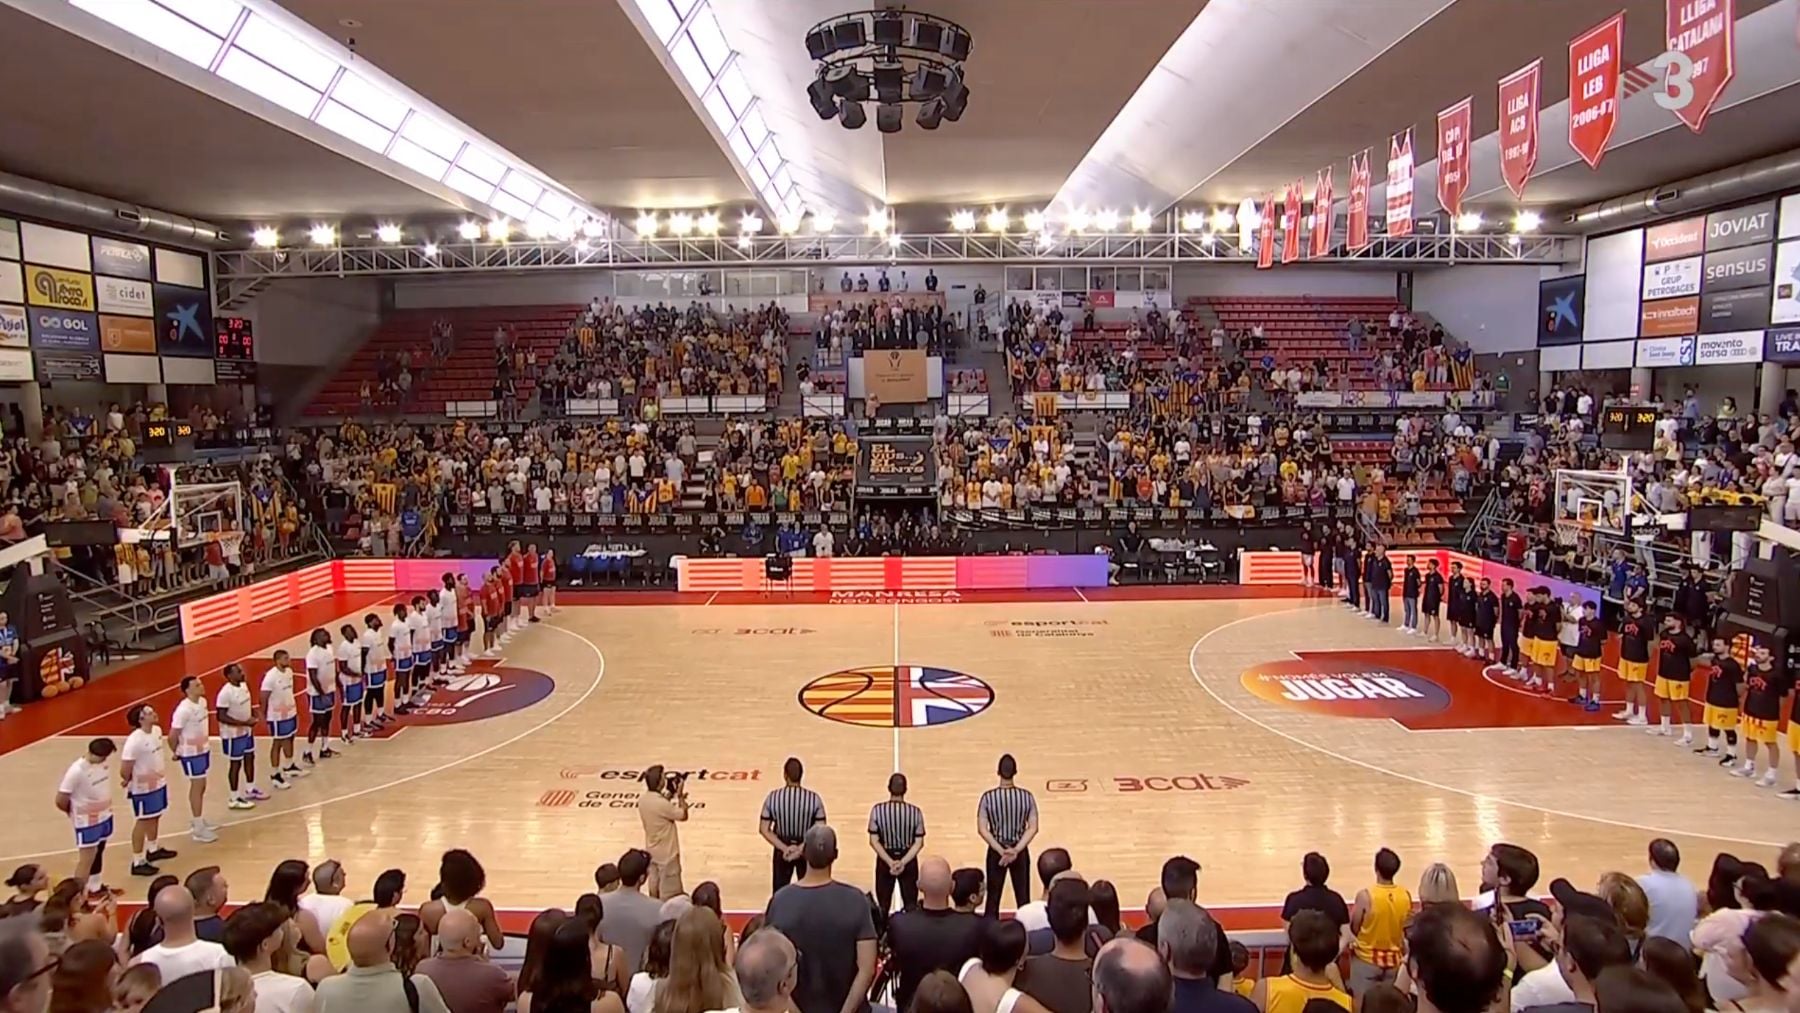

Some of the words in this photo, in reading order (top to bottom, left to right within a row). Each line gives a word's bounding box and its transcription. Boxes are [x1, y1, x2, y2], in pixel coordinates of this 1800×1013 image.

[1577, 44, 1610, 76] LLIGA
[1583, 74, 1604, 100] LEB
[1709, 211, 1769, 239] JOVIAT
[1706, 258, 1767, 280] sensus
[1660, 275, 1682, 287] GRUP
[63, 318, 89, 331] GOL
[831, 590, 962, 598] MANRESA
[1279, 678, 1426, 701] JUGAR
